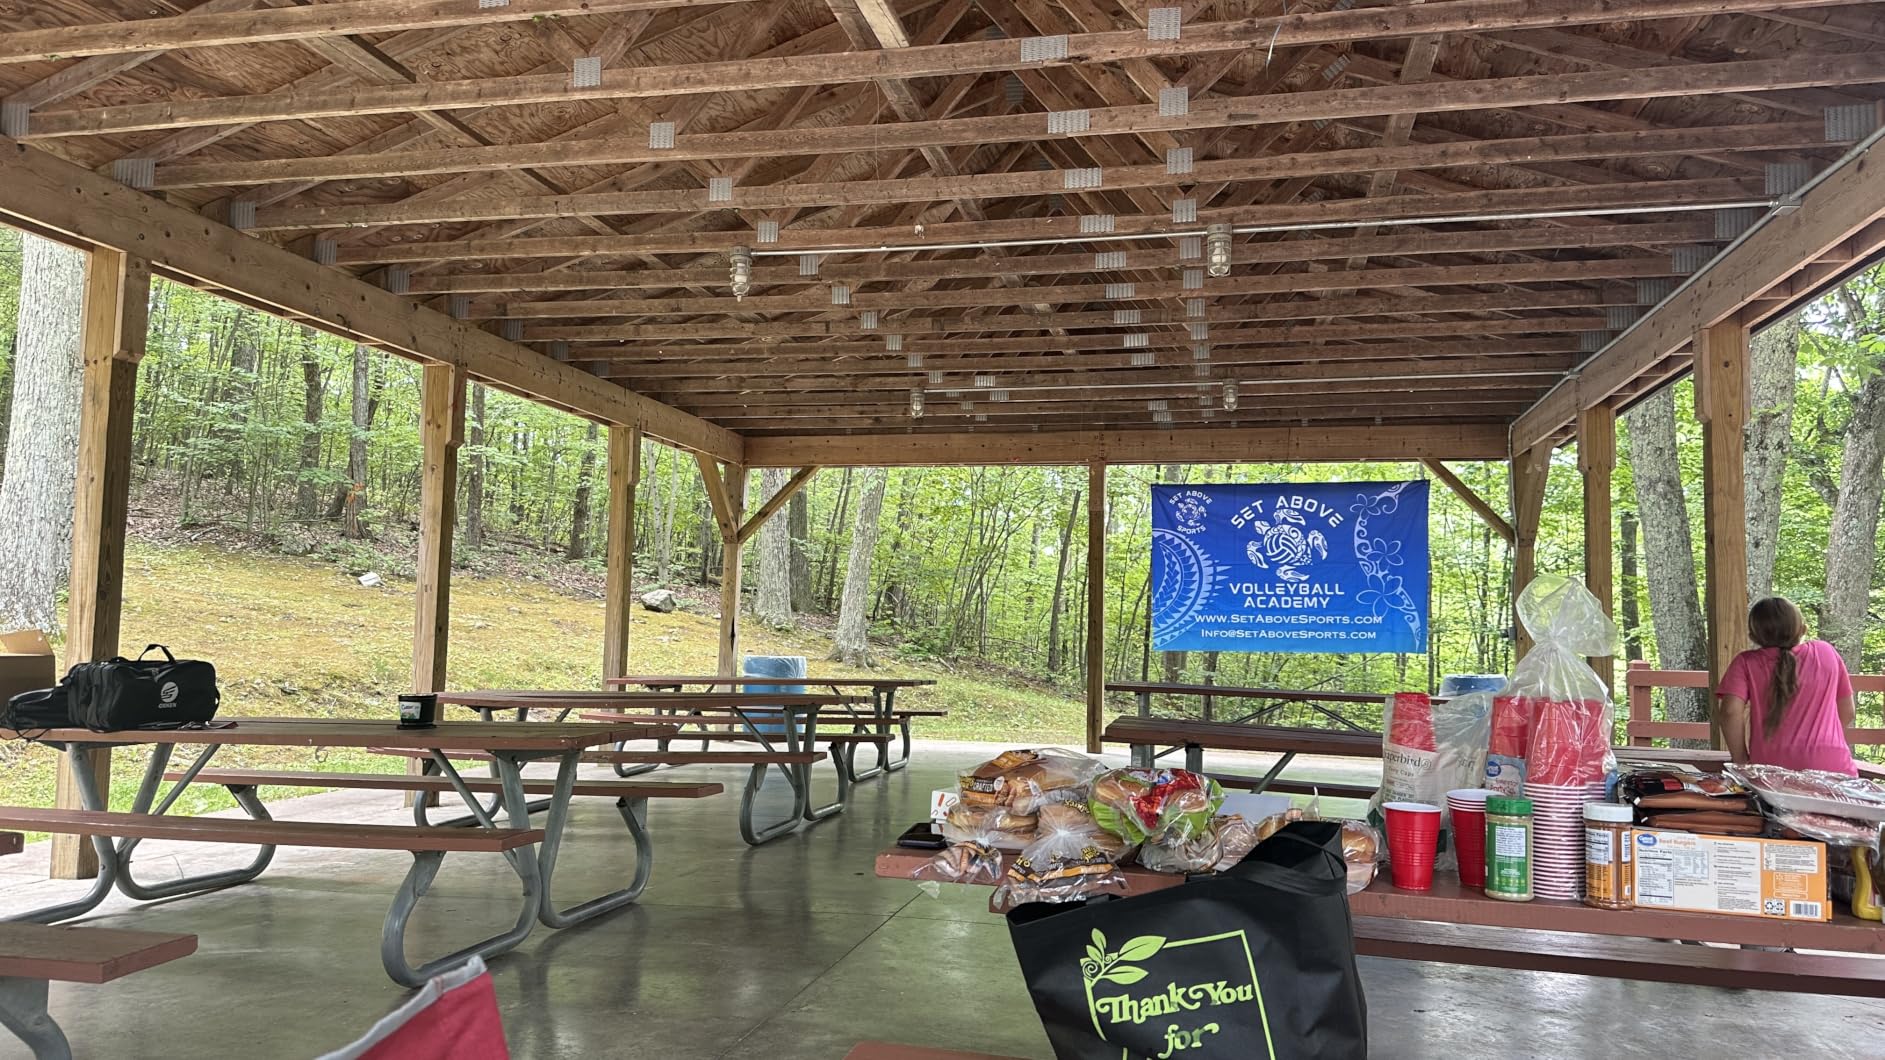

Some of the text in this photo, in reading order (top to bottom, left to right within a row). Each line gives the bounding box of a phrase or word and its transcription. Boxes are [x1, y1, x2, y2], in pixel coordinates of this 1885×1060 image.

[1169, 490, 1213, 505] SET ABOVE
[1230, 495, 1345, 529] SET ABOVE
[1176, 525, 1206, 535] SPORTS
[1229, 583, 1345, 596] VOLLEYBALL
[1243, 597, 1330, 609] ACADEMY
[1383, 751, 1421, 767] aperbird
[1096, 980, 1254, 1024] Thank You
[1157, 1022, 1220, 1060] for
